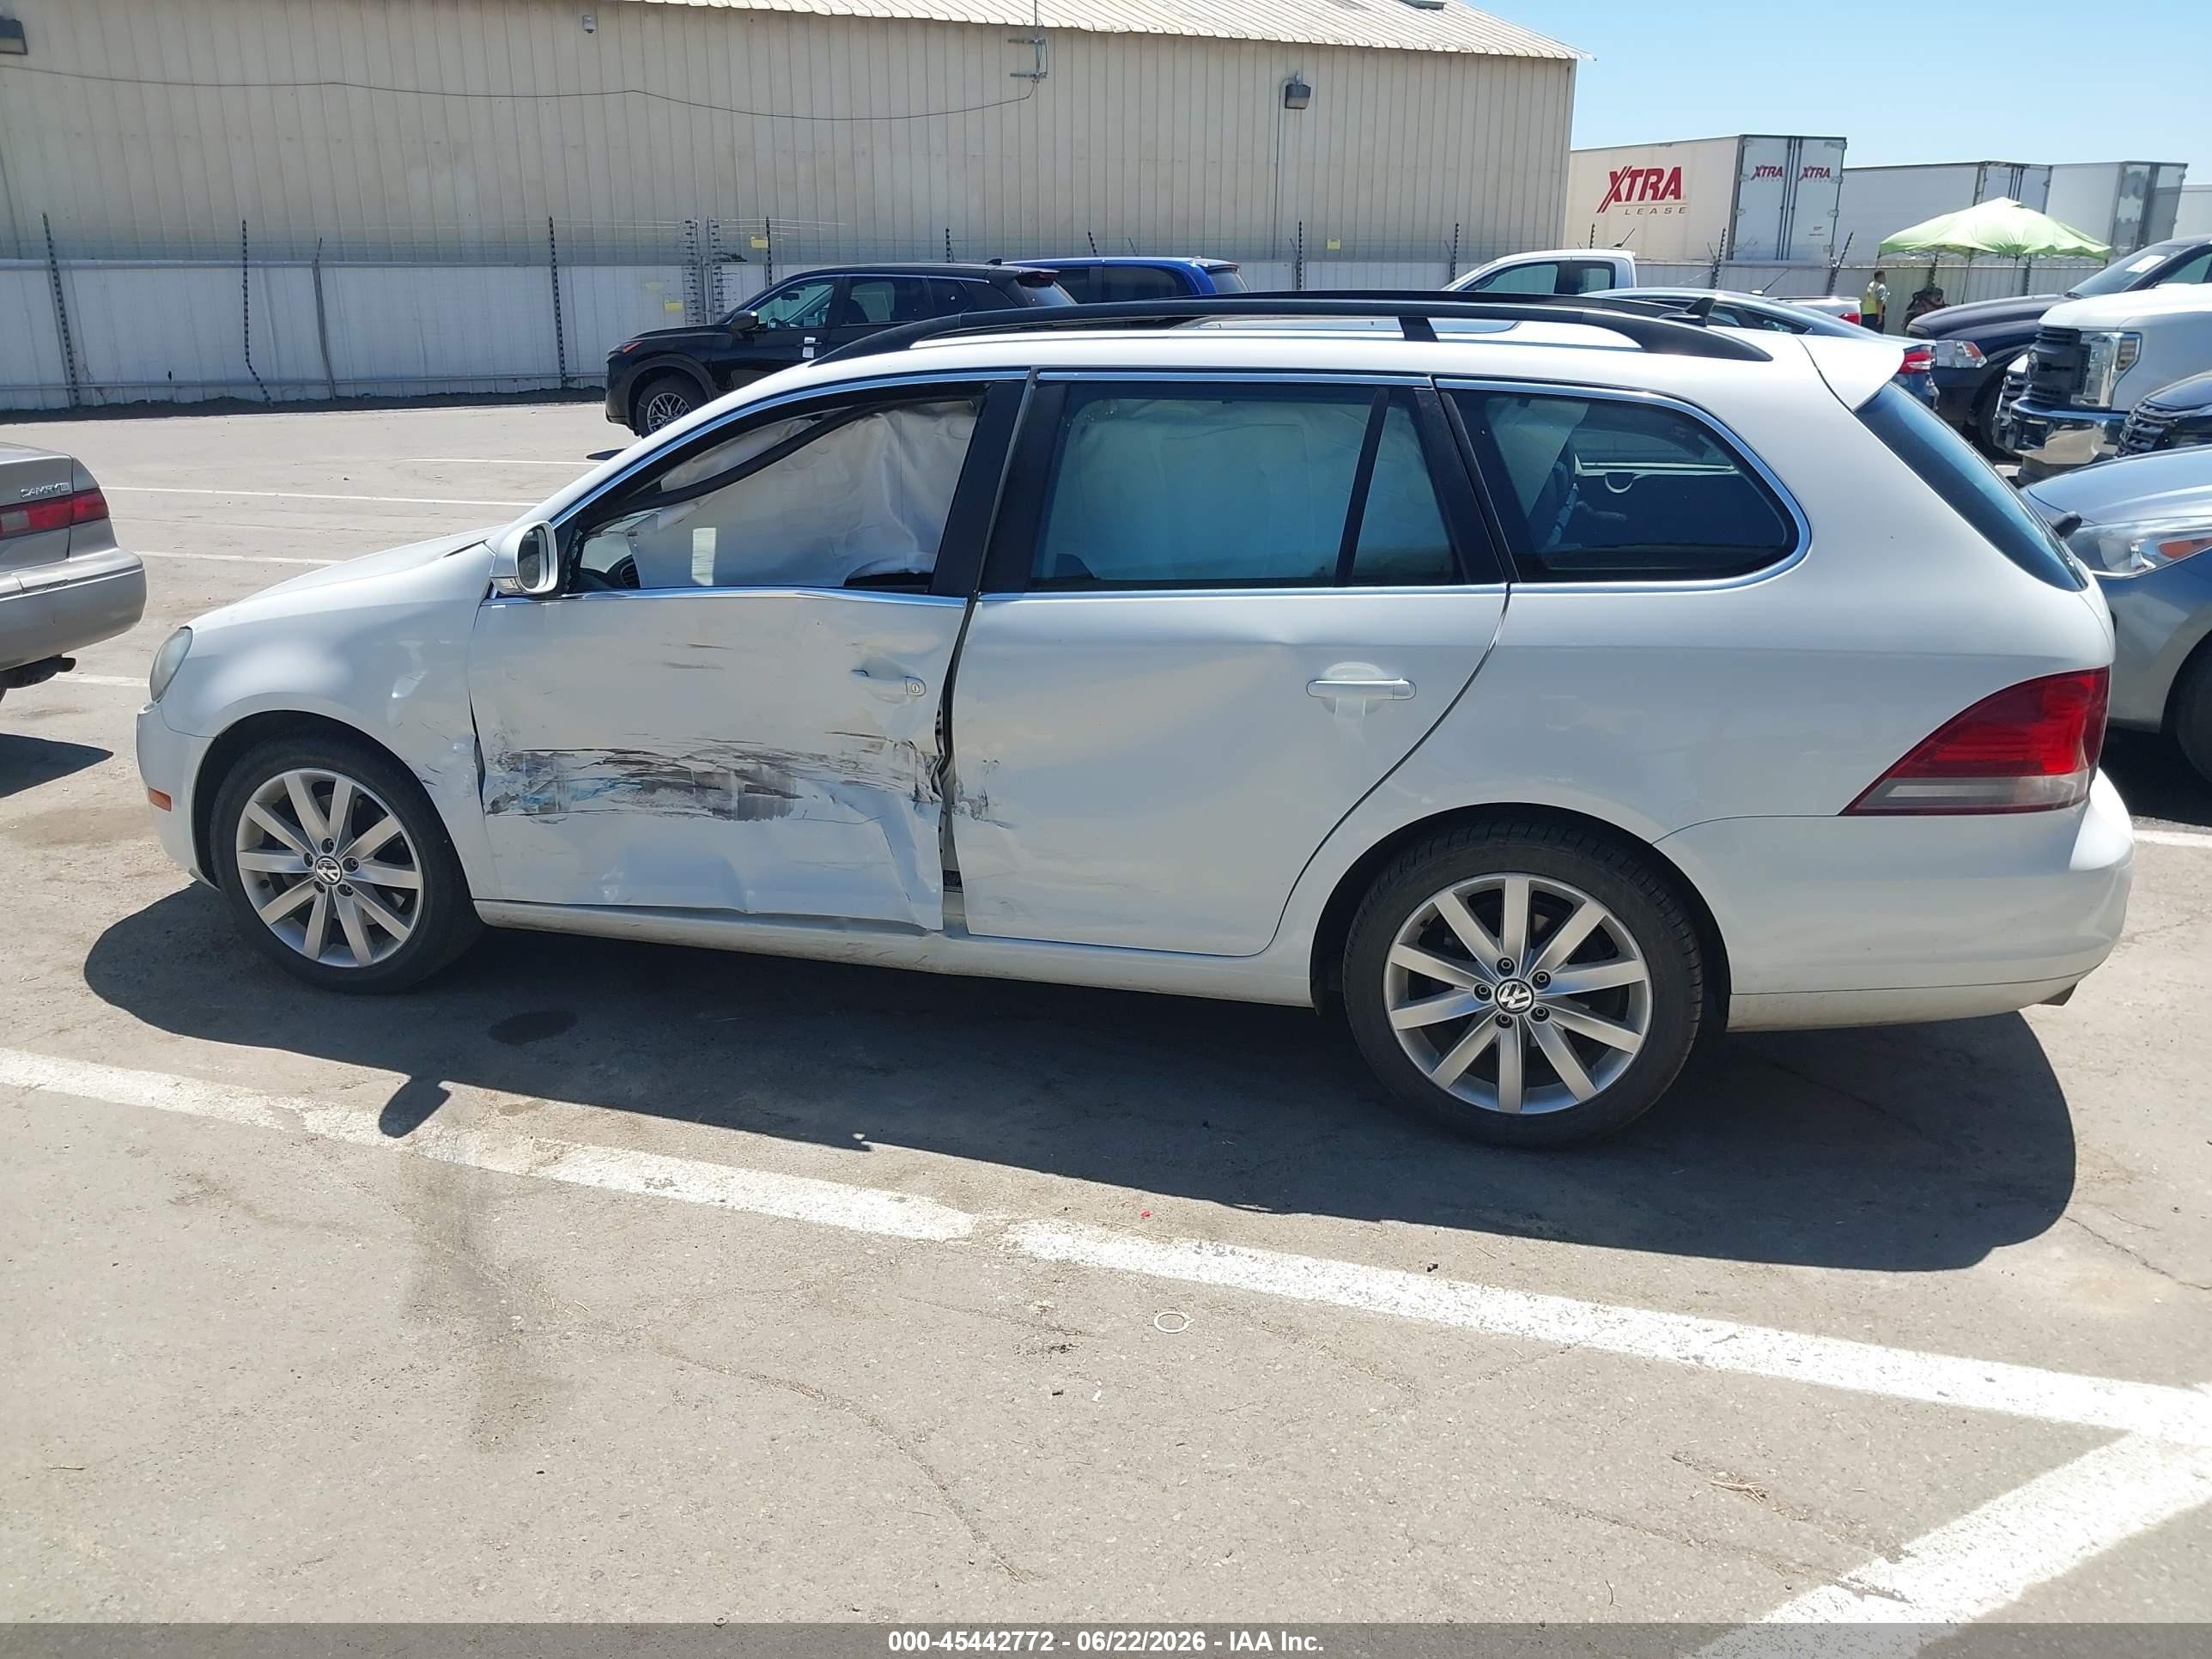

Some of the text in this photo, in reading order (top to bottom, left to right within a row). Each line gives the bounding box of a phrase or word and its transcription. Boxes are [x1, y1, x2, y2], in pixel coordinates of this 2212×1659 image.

[1751, 165, 1784, 180] XTRA
[1799, 166, 1831, 181] XTRA
[1597, 165, 1682, 213] XTRA
